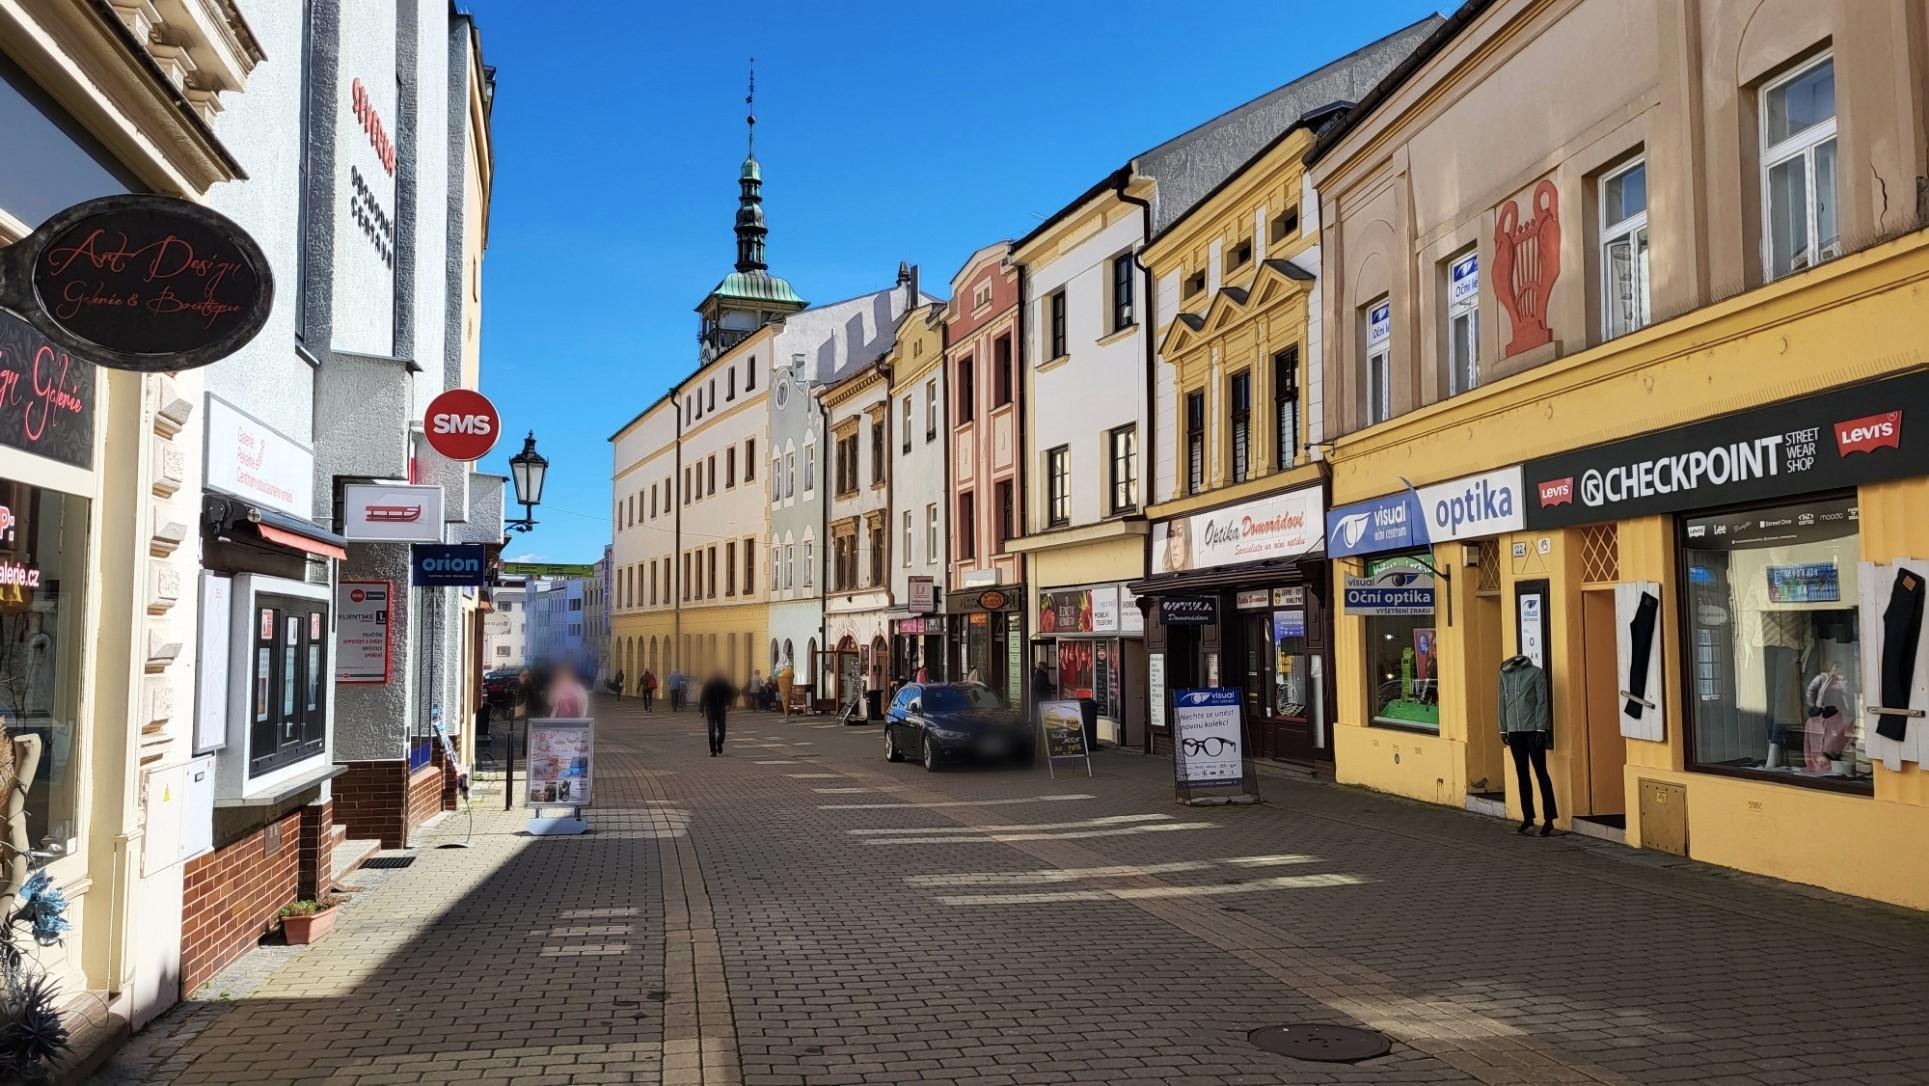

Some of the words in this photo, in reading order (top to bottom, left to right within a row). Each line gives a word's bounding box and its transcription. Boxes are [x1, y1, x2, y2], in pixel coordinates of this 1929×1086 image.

[48, 229, 137, 276] Art
[144, 235, 241, 298] Design
[433, 413, 491, 435] SMS
[1785, 427, 1820, 446] STREET
[1786, 442, 1816, 459] WEAR
[1604, 434, 1783, 502] CHECKPOINT
[1787, 457, 1815, 473] SHOP
[1374, 500, 1406, 527] visual
[1436, 479, 1513, 536] optika
[1204, 519, 1240, 552] Optika
[1713, 524, 1727, 535] Lee
[422, 552, 479, 571] orion
[1347, 578, 1375, 586] visual
[1348, 590, 1382, 603] Oční
[1384, 590, 1431, 606] optika
[1211, 691, 1235, 699] visual
[1180, 712, 1205, 721] Nechte
